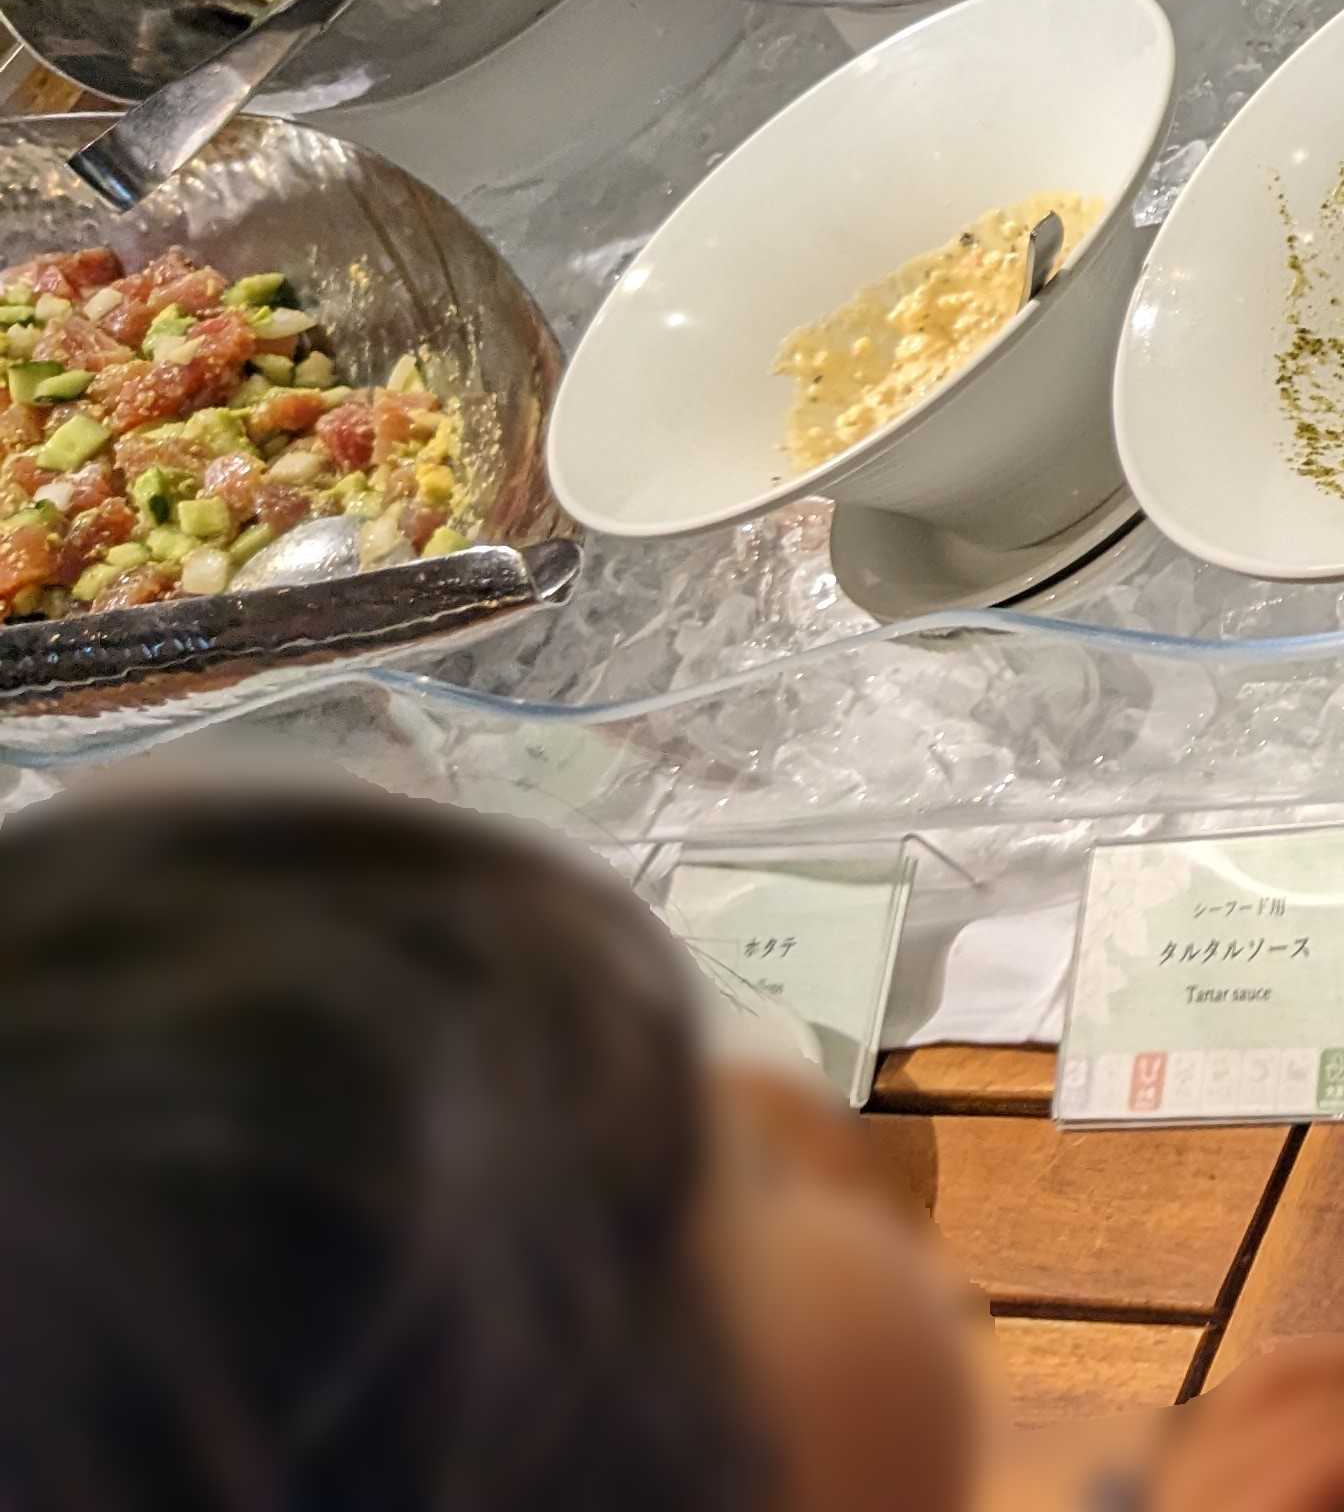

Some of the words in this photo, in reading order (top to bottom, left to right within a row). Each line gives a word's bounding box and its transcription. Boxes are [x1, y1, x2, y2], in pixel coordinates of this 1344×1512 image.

[743, 937, 797, 958] ホタテ
[1159, 938, 1310, 966] タルタルソース
[1232, 987, 1273, 1002] sauce
